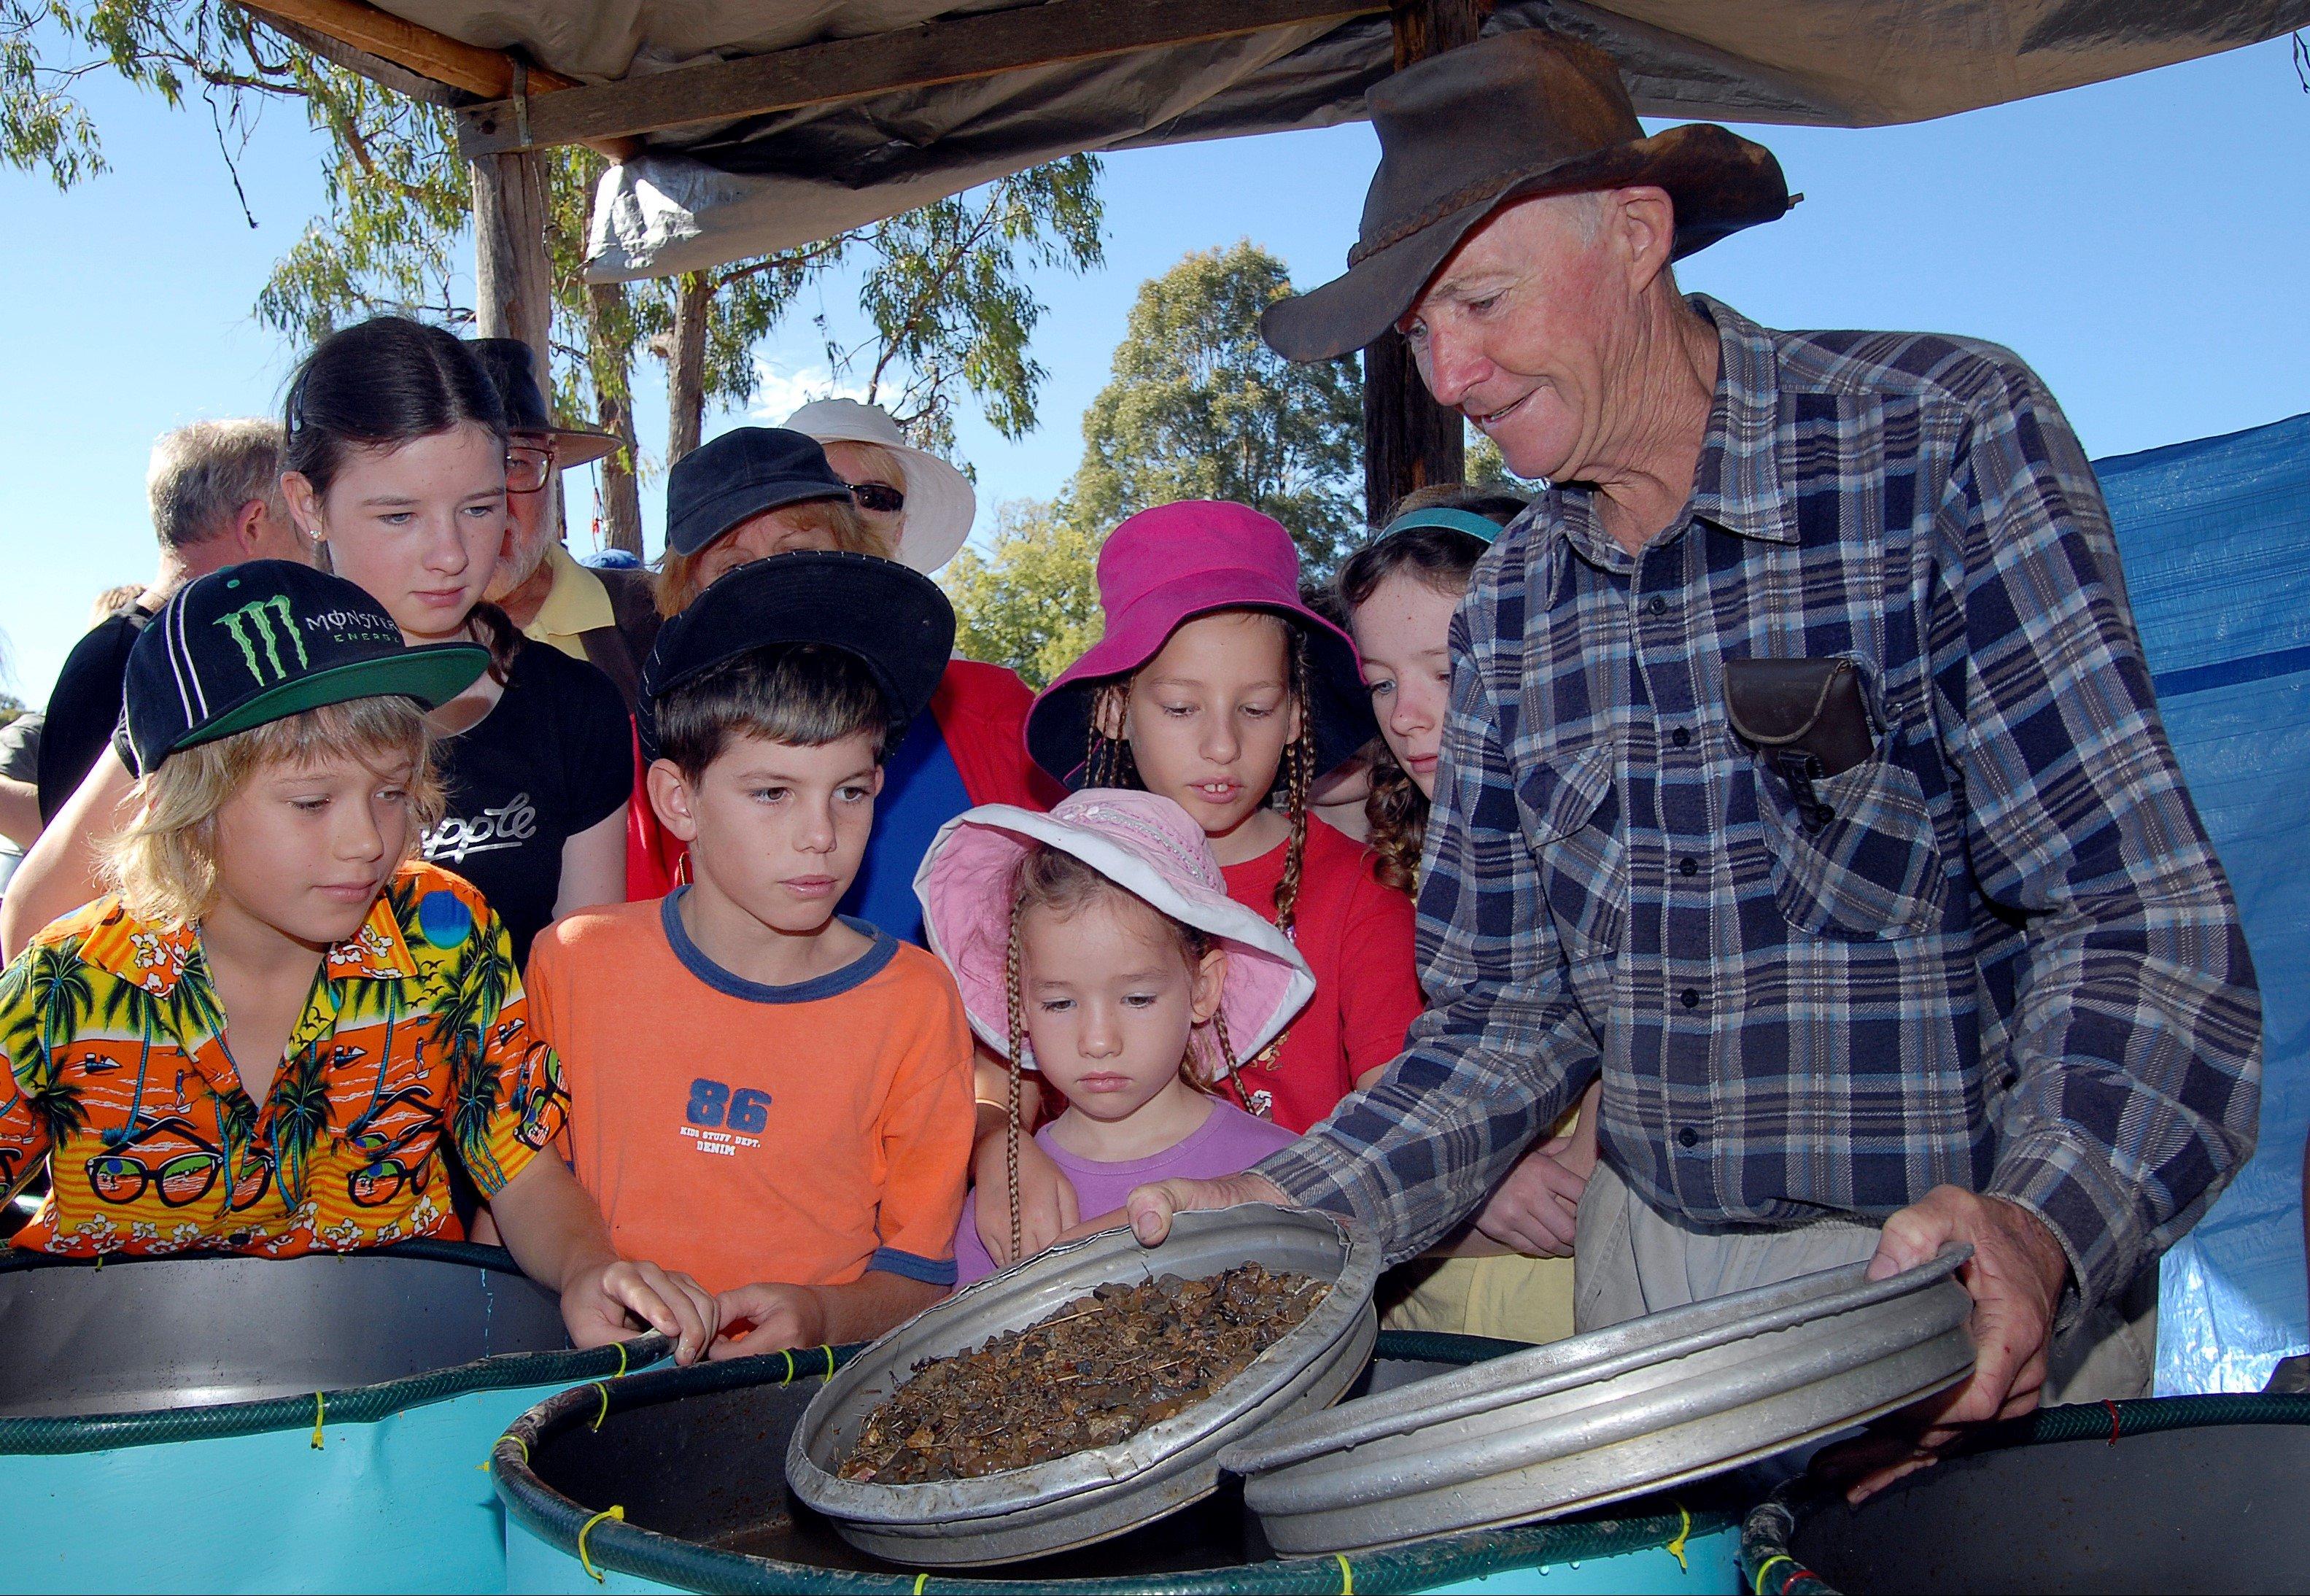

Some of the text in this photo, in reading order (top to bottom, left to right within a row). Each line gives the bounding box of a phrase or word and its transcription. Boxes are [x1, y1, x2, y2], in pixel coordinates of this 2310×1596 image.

[305, 610, 402, 634] MONSTER
[420, 792, 537, 864] pple
[687, 1078, 772, 1134] 86
[680, 1126, 761, 1148] KIDS STUFF DEPT.
[697, 1141, 736, 1156] DENIM
